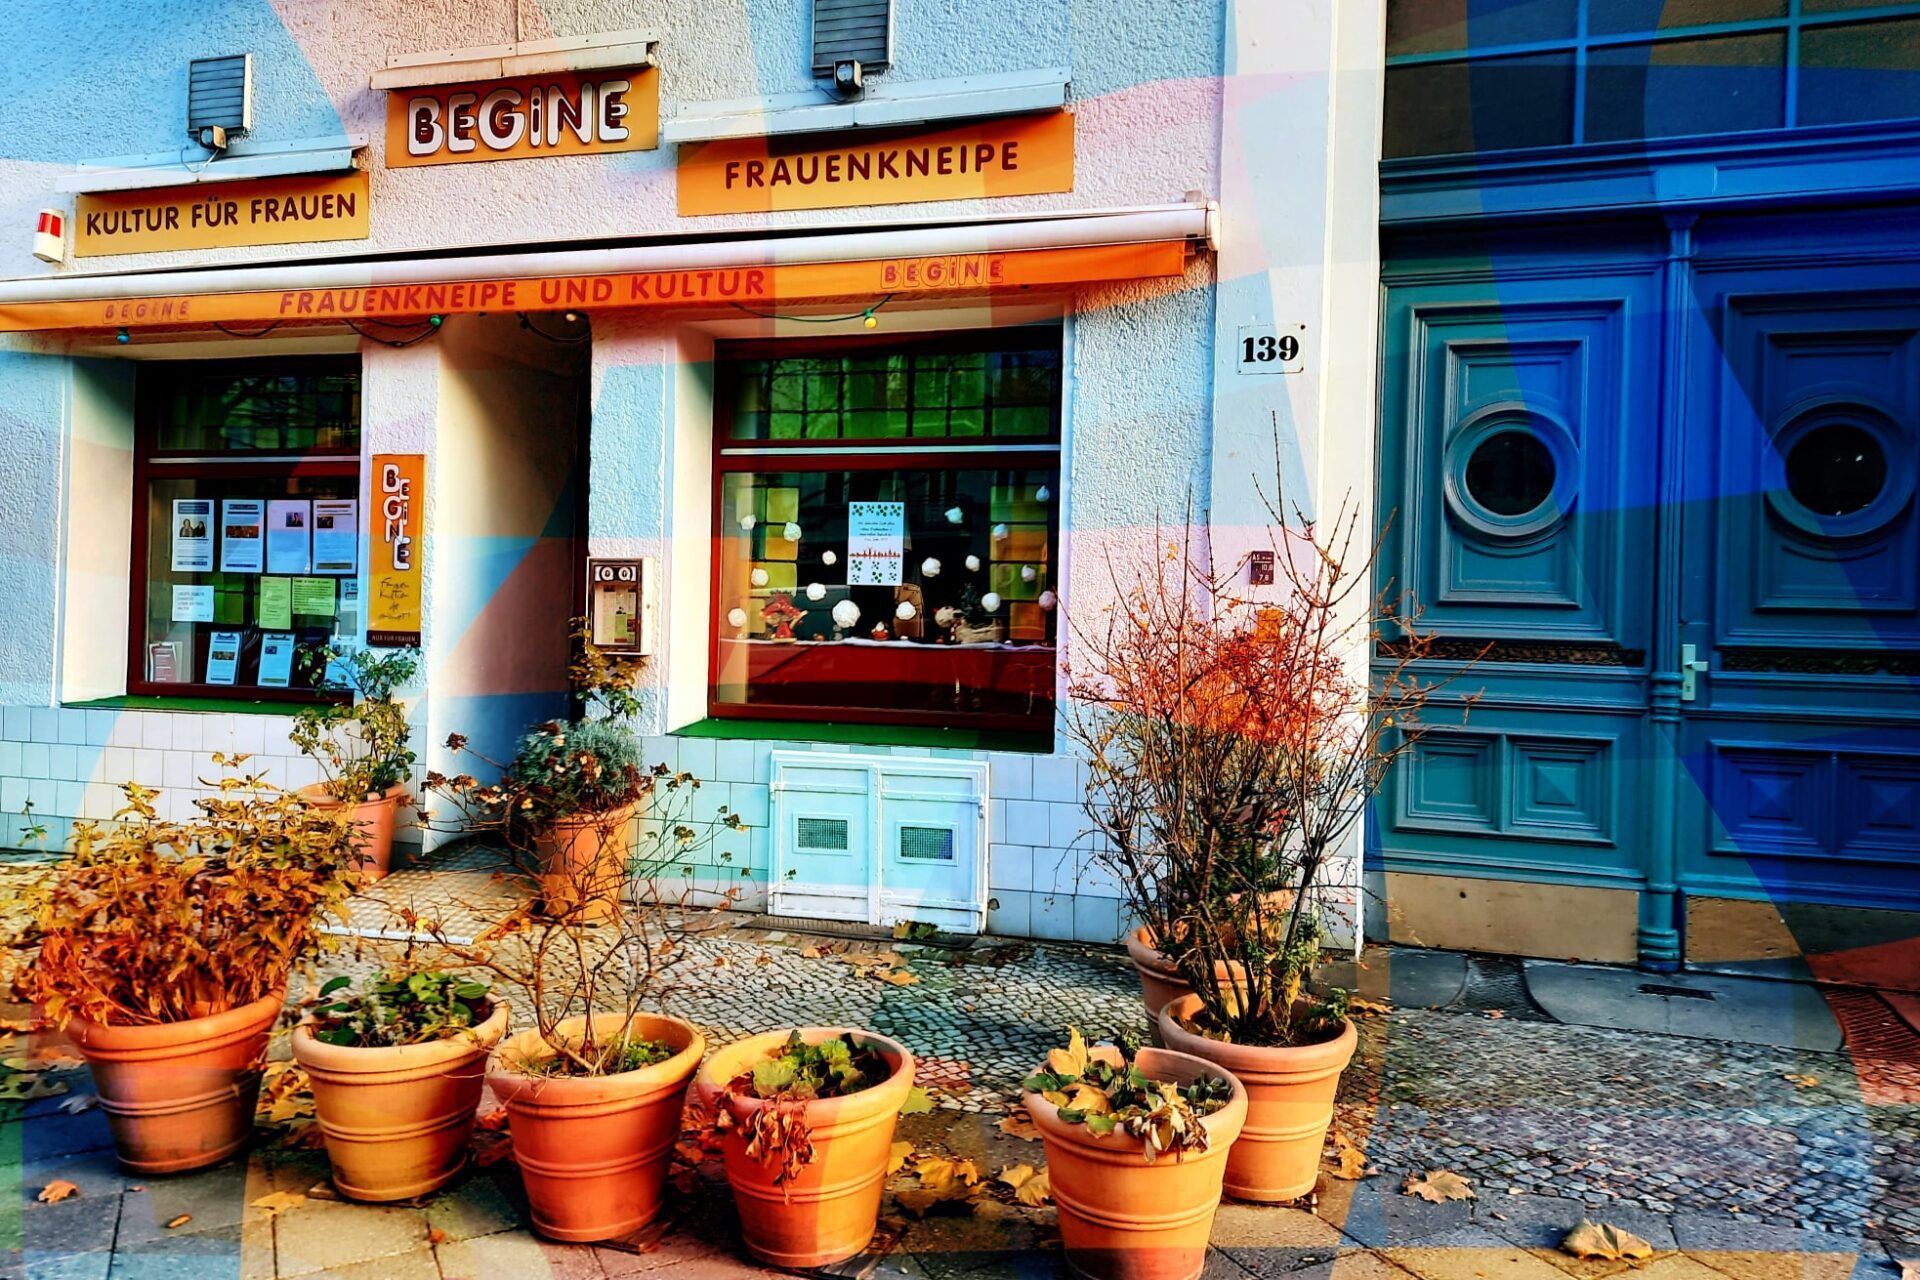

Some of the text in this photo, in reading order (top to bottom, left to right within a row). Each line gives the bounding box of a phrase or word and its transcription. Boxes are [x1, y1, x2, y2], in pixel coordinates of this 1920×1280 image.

[724, 141, 1020, 189] FRAUENKNEIPE
[86, 192, 356, 236] KULTUR FÜR FRAUEN
[278, 282, 518, 314] FRAUENKNEIPE
[539, 278, 613, 304] UND
[630, 269, 766, 300] KULTUR
[1243, 336, 1299, 362] 139
